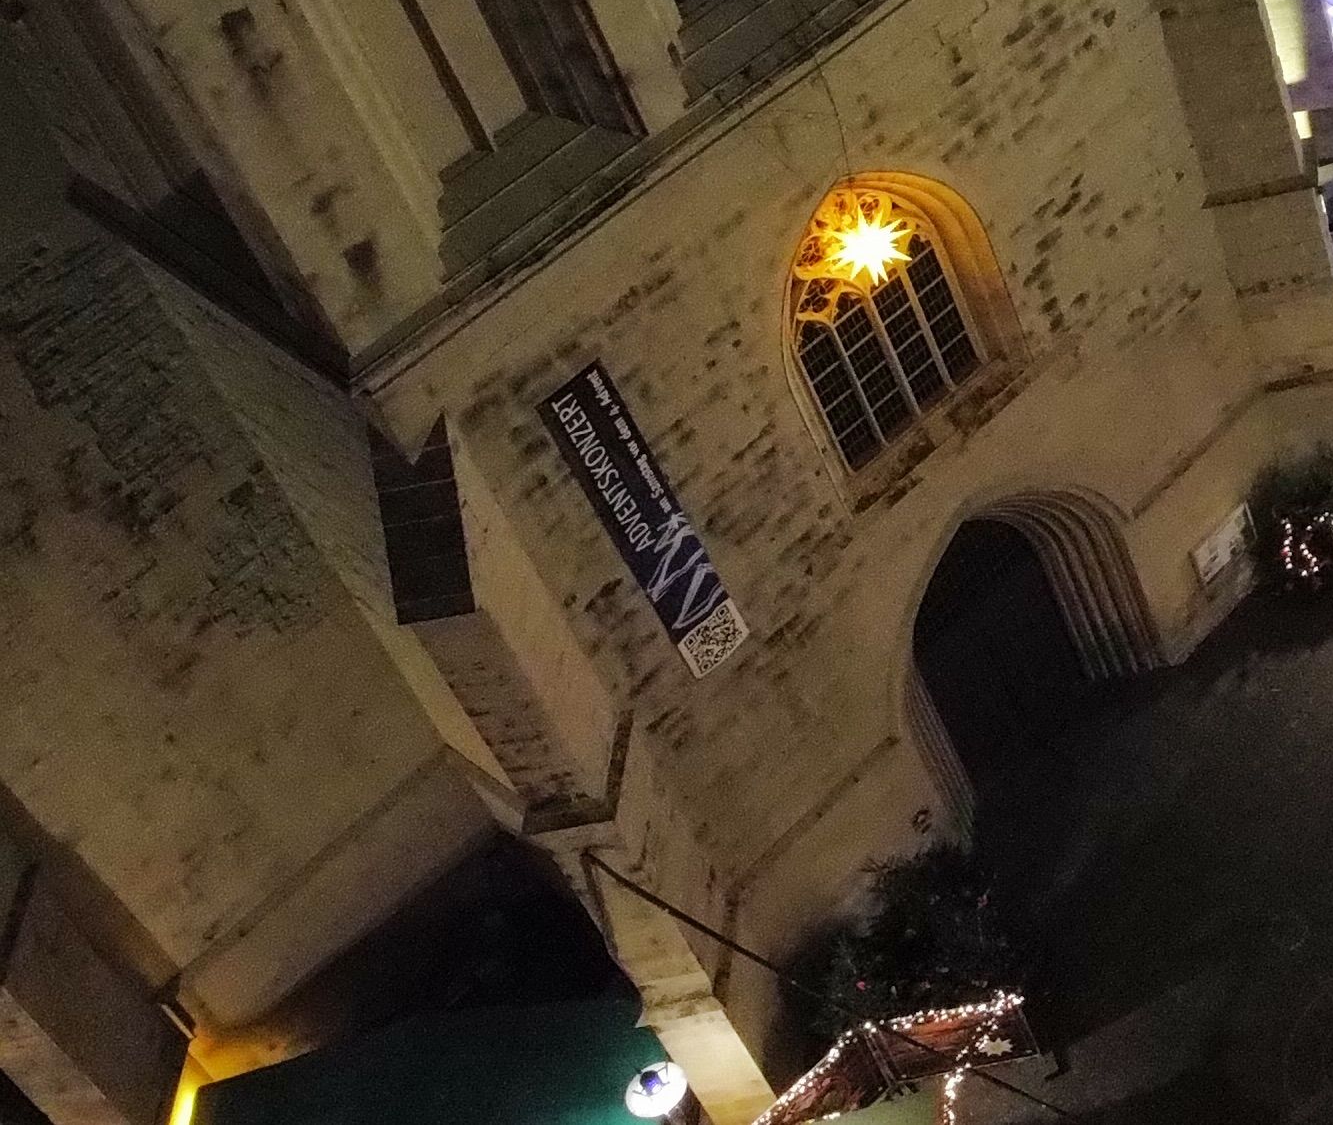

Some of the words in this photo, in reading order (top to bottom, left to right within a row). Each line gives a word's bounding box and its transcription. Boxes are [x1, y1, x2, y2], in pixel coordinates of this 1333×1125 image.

[586, 369, 612, 406] Advent
[614, 416, 632, 440] dem
[627, 440, 640, 458] vor
[551, 392, 656, 553] ADVENTSKONZERT
[636, 453, 665, 499] Samstag
